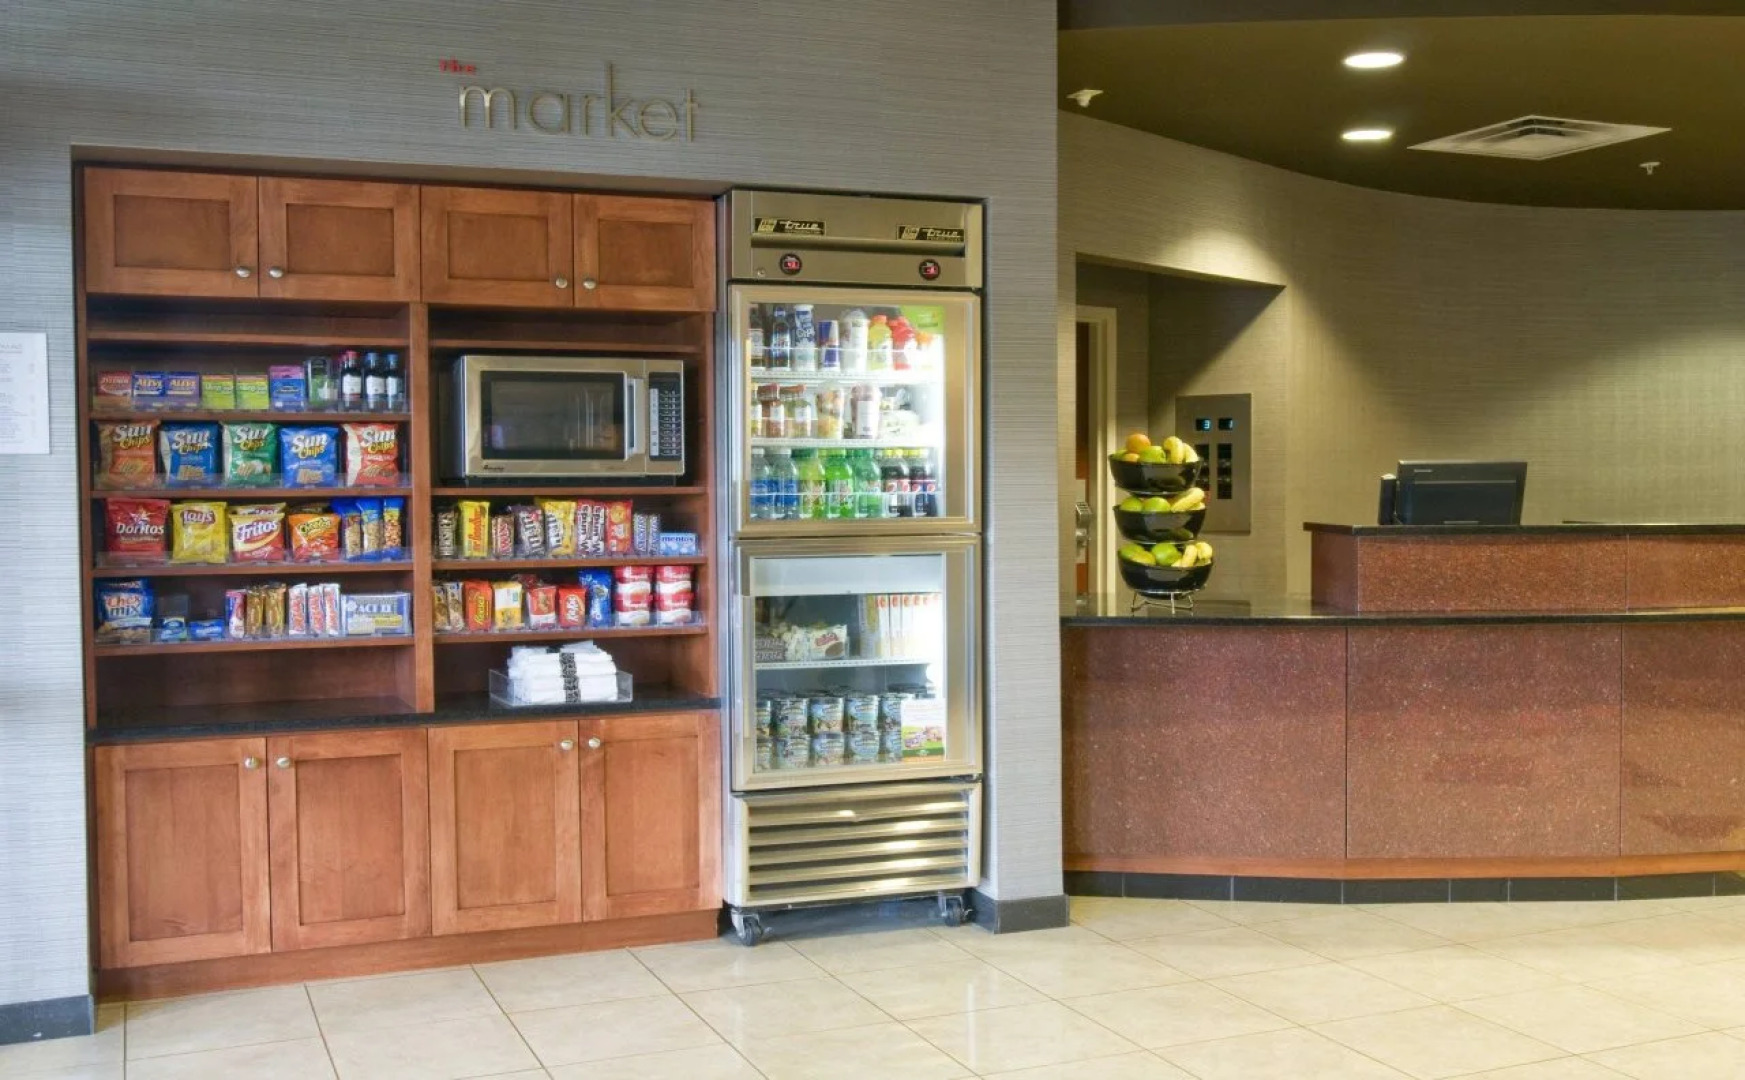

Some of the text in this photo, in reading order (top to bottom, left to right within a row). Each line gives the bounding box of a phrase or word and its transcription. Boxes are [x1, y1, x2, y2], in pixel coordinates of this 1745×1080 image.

[459, 60, 699, 142] market
[113, 424, 152, 442] Sun
[171, 429, 210, 449] Sun
[234, 424, 269, 443] Sun
[360, 428, 396, 446] Sun
[291, 433, 328, 453] Sun
[298, 445, 325, 459] Chips
[115, 521, 165, 535] Doritos
[237, 518, 278, 542] Fritos
